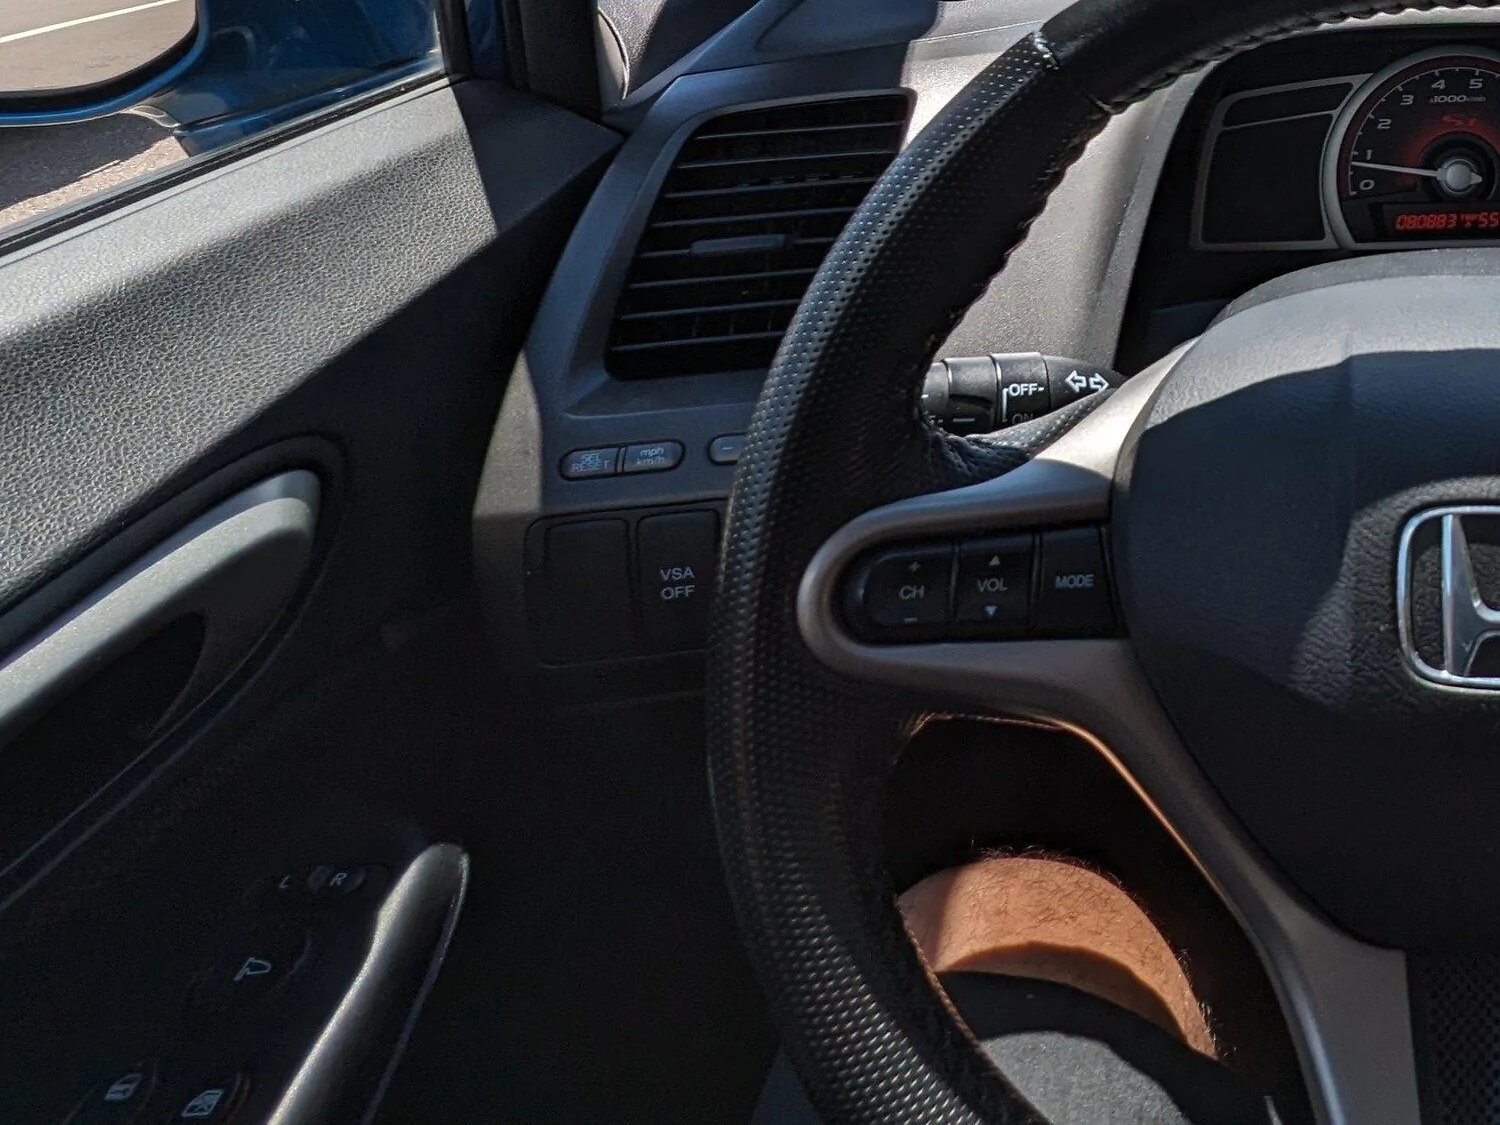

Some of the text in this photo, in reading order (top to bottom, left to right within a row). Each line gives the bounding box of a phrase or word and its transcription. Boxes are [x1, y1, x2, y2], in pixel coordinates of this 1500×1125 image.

[1431, 78, 1446, 90] 4
[1469, 78, 1484, 89] 5
[1401, 94, 1414, 106] 3
[1377, 118, 1392, 130] 2
[1366, 149, 1373, 160] 1
[1360, 179, 1375, 191] 0
[1008, 383, 1039, 397] OFF
[660, 566, 695, 581] VSA
[977, 578, 1008, 592] VOL
[1055, 574, 1094, 589] MODE
[660, 585, 696, 600] OFF
[899, 585, 925, 601] CH
[329, 871, 348, 886] R
